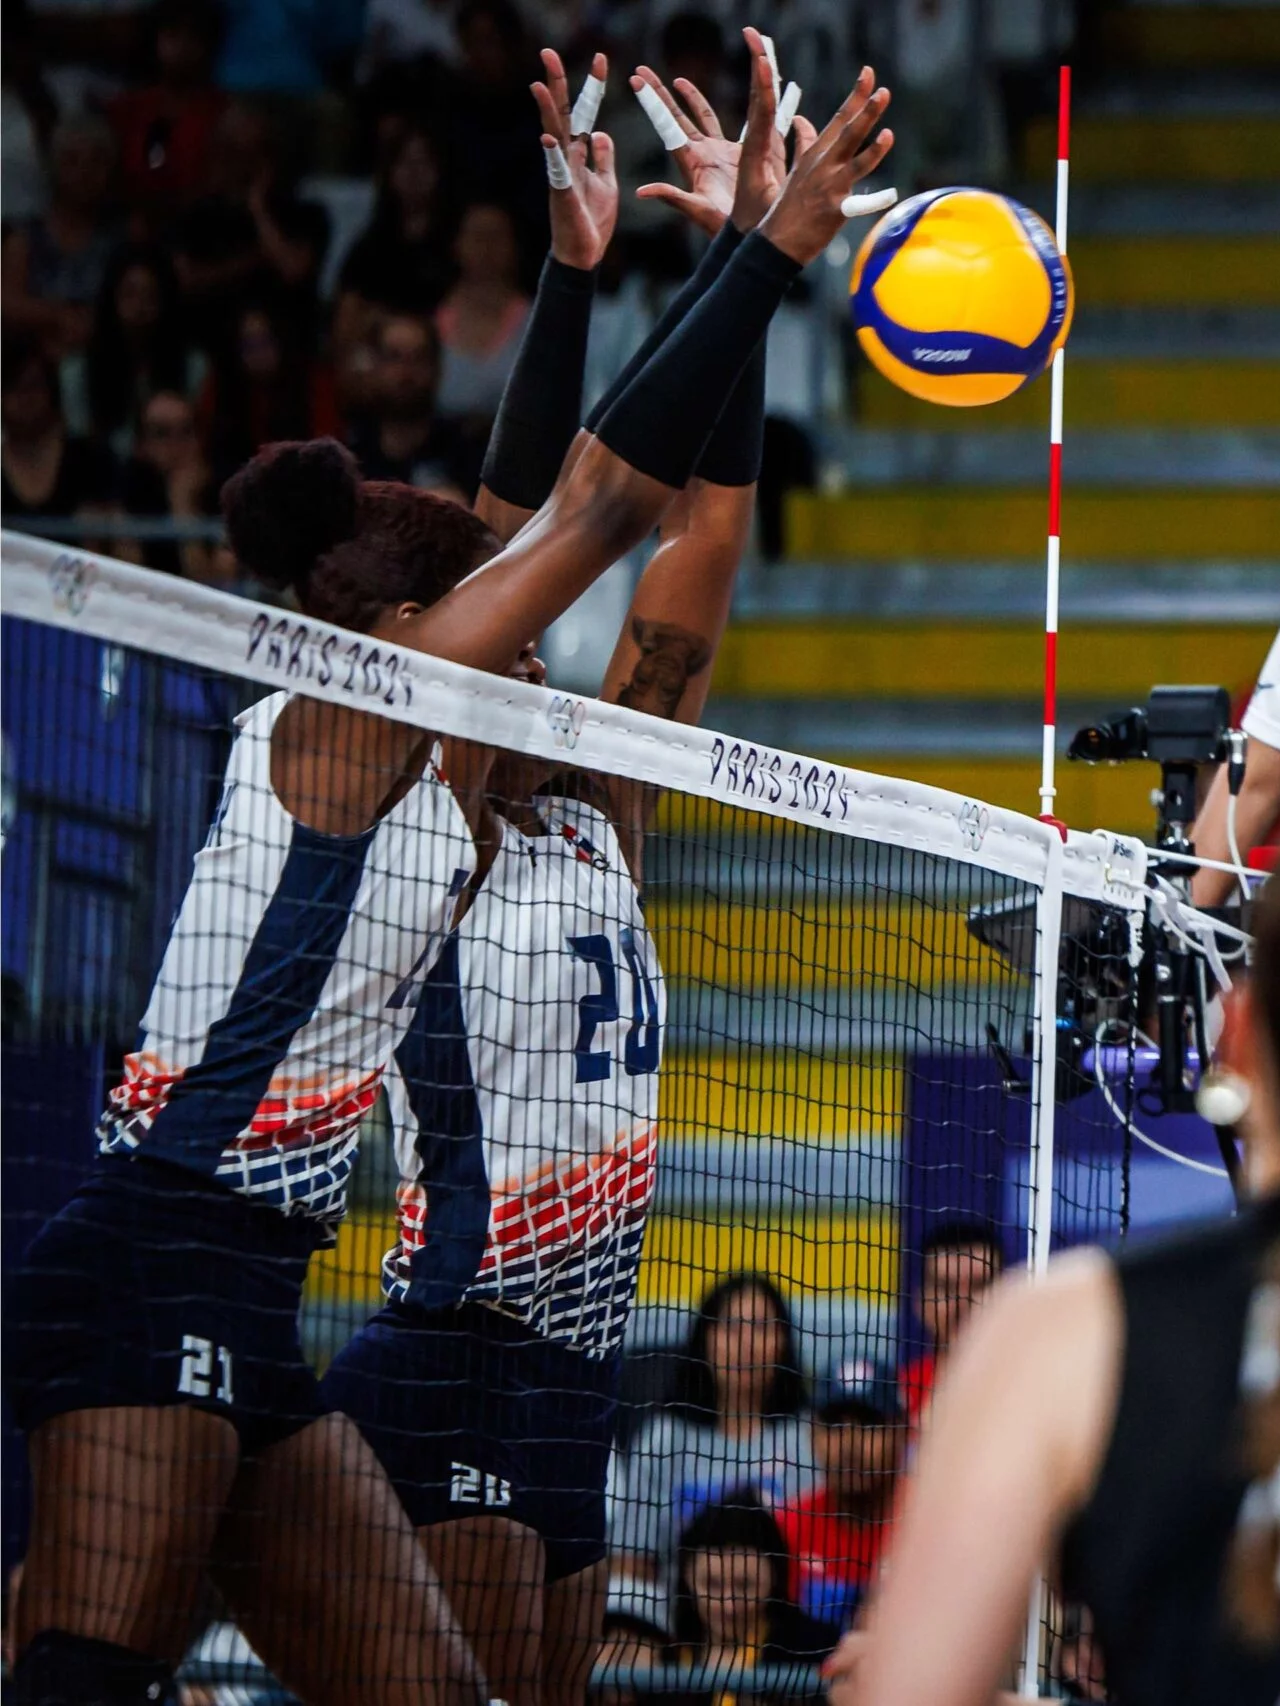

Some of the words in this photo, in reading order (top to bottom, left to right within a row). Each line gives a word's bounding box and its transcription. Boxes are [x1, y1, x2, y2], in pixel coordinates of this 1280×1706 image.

[912, 347, 972, 362] V200W
[246, 612, 339, 687] PARIS
[342, 642, 415, 707] 2024
[709, 737, 783, 804] PARIS
[787, 760, 859, 821] 2024
[565, 927, 659, 1084] 20
[177, 1334, 234, 1405] 21
